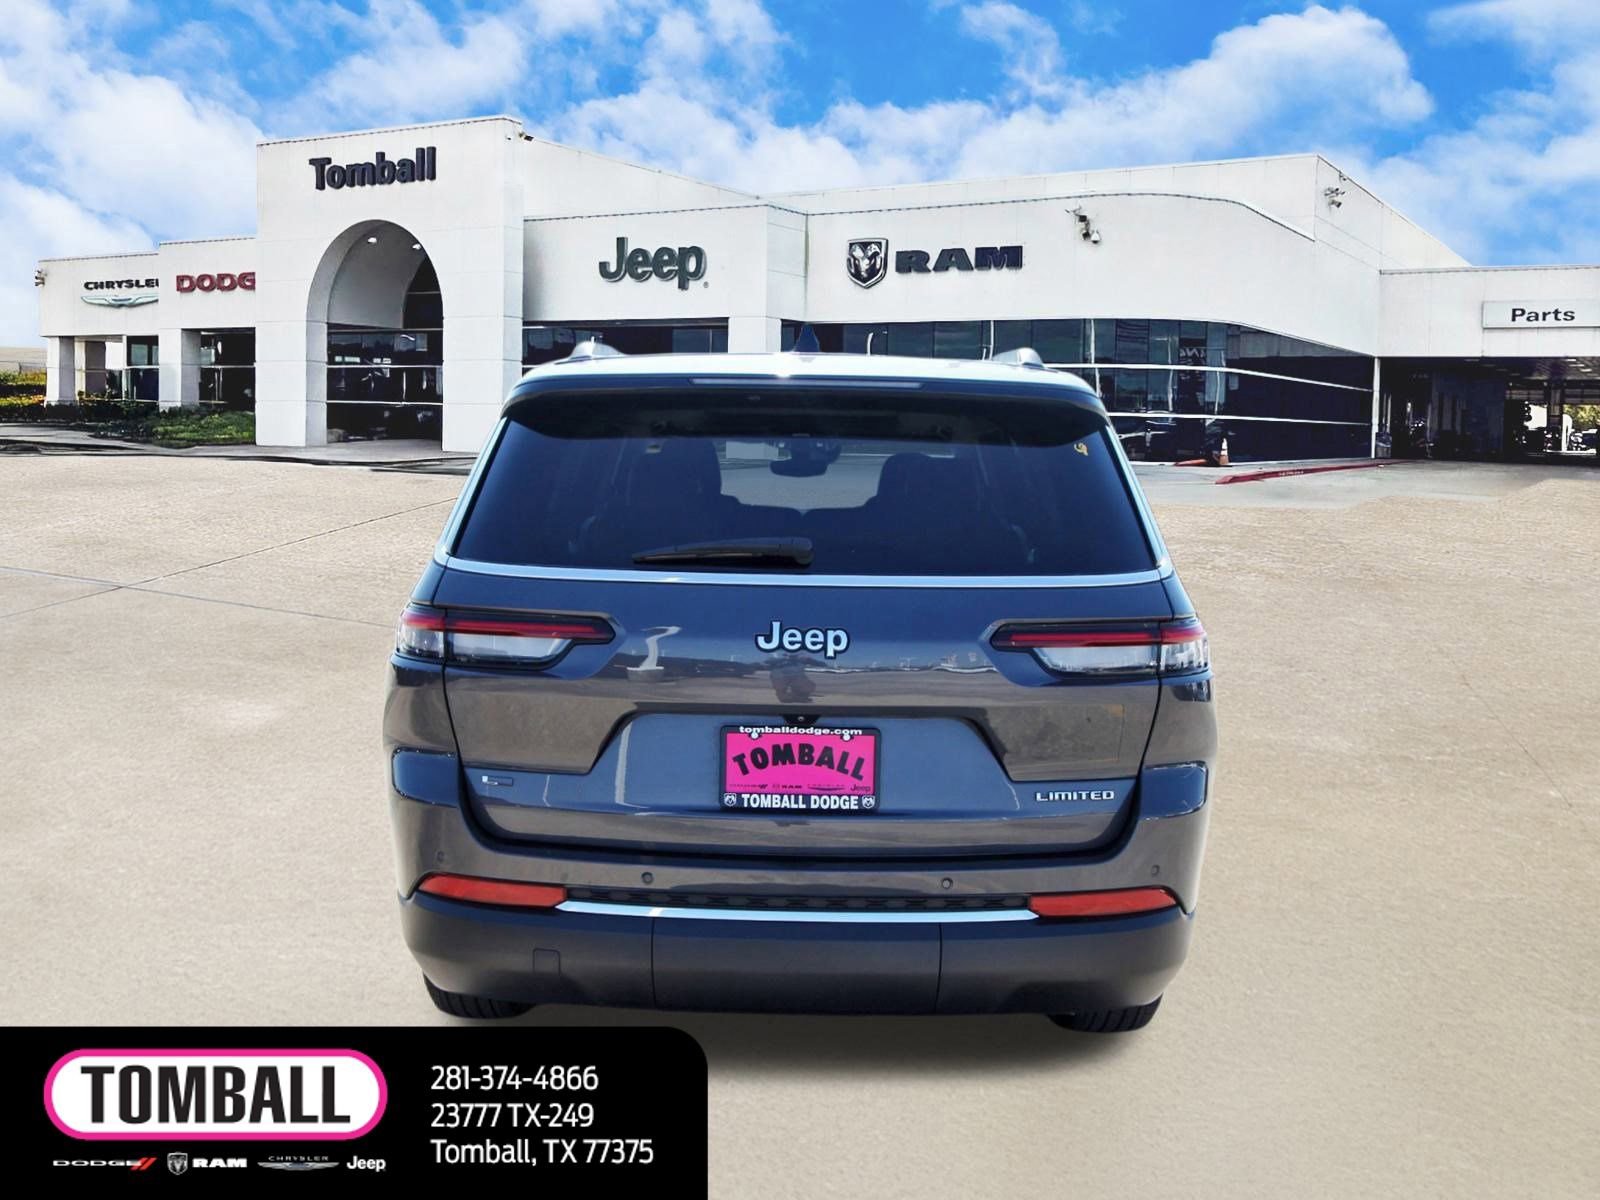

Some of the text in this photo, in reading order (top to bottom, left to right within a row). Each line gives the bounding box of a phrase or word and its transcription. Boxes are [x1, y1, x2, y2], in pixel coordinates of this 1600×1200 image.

[309, 146, 437, 191] Tomball
[598, 236, 708, 291] Jeep
[895, 245, 1023, 274] RAM
[1511, 307, 1576, 322] Parts
[755, 621, 849, 658] Jeep
[739, 725, 863, 736] tomballdodge.com
[732, 743, 866, 781] TOMBALL
[741, 793, 859, 810] TOMBALL DODGE
[1035, 790, 1115, 801] LIMITED
